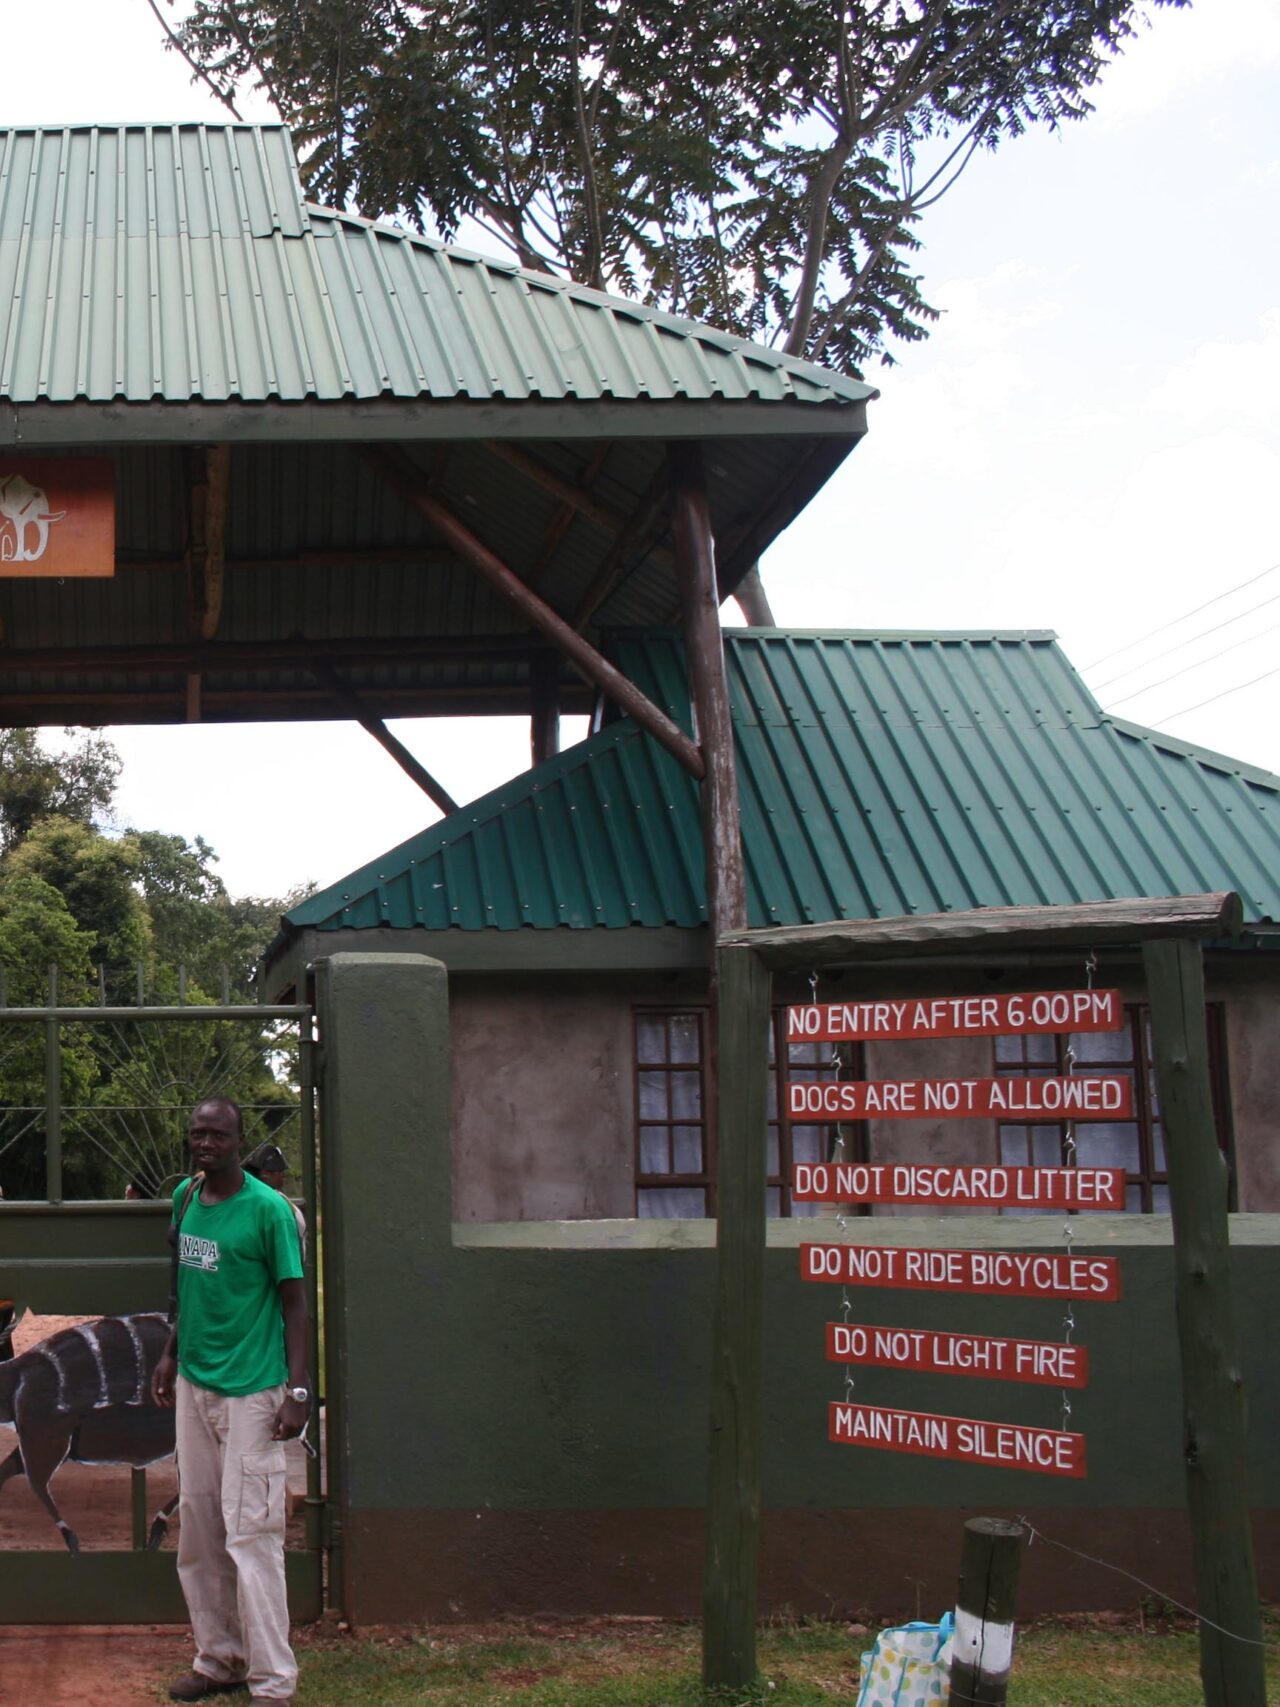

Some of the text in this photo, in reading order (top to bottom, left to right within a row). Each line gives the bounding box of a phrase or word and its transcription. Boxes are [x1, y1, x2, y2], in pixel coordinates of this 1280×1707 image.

[788, 1007, 821, 1036] NO
[827, 1003, 907, 1034] ENTRY
[912, 998, 1000, 1030] AFTER
[790, 1079, 1122, 1112] DOGS ARE NOT ALLOWED
[795, 1165, 1115, 1202] DO NOT DISCARD LITTER
[809, 1247, 1109, 1292] DO NOT RIDE BICYCLES
[834, 1326, 1076, 1379] DO NOT LIGHT FIRE
[835, 1407, 1074, 1469] MAINTAIN SILENCE
